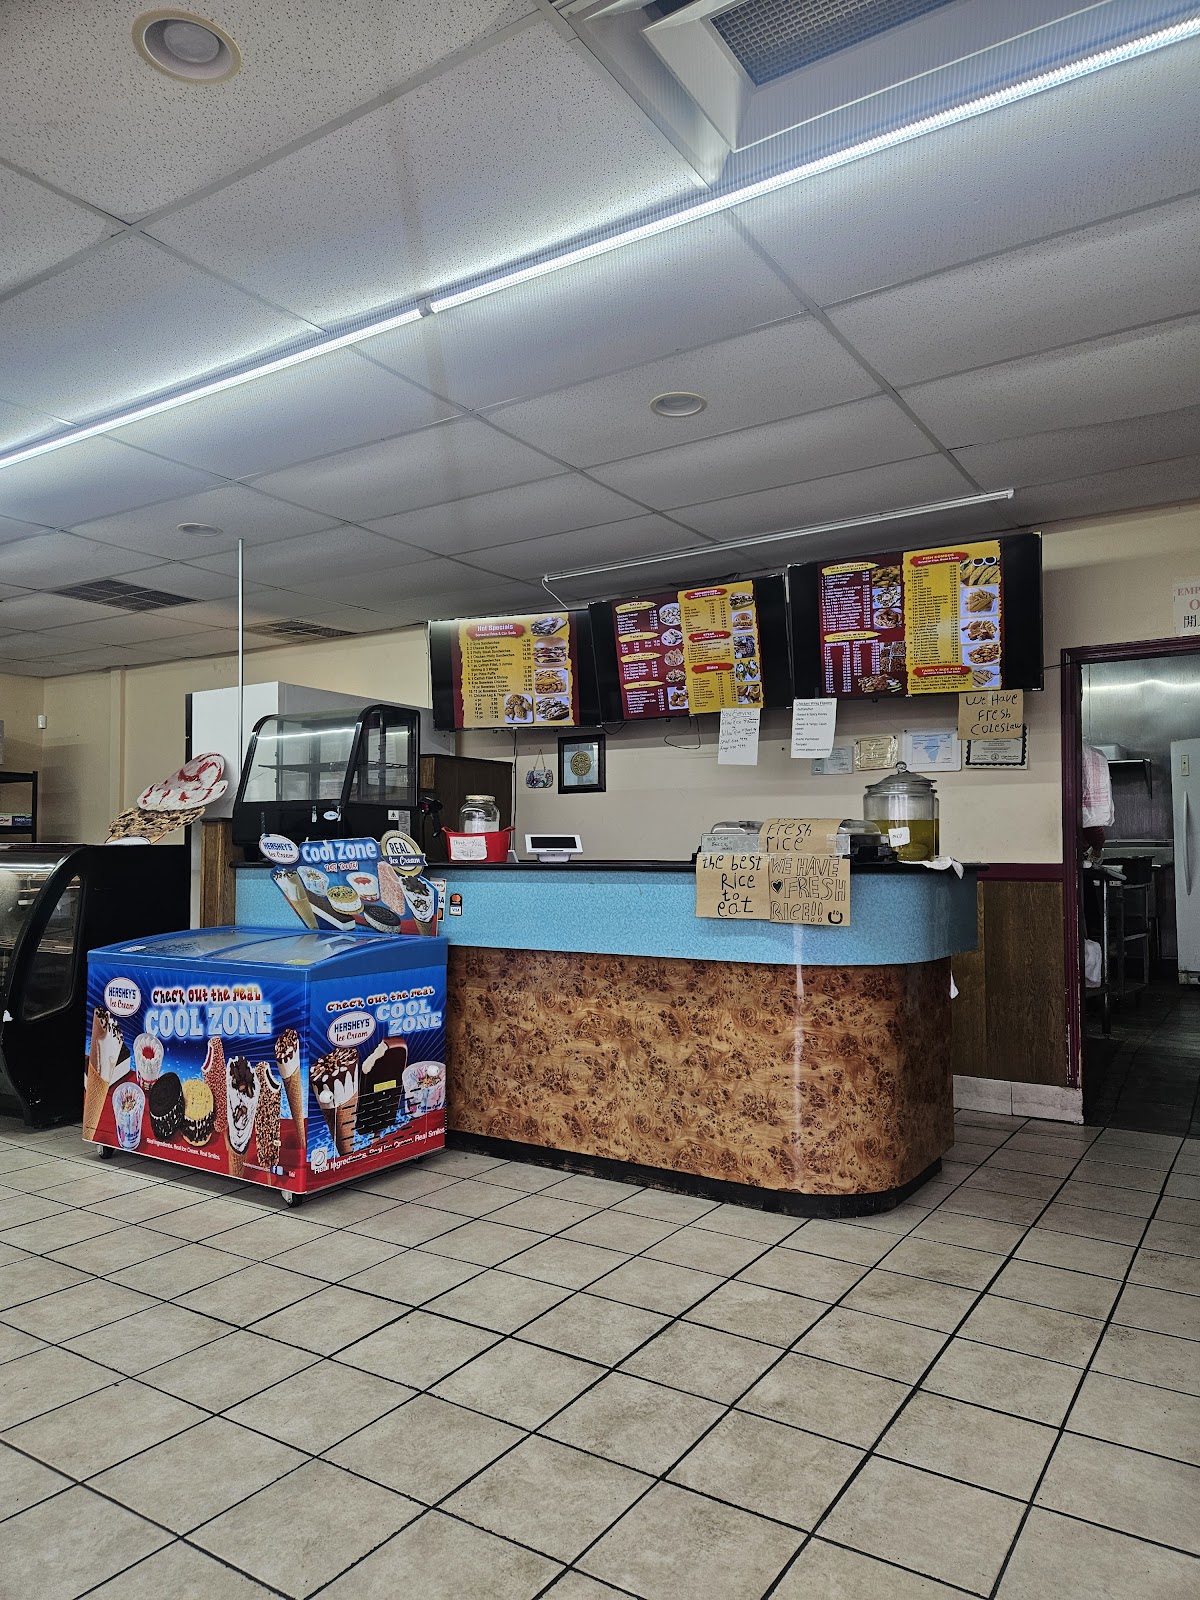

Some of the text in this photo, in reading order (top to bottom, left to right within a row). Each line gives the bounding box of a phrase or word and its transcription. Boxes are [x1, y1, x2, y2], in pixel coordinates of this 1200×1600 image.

[488, 623, 514, 631] Specials
[966, 694, 1018, 706] We Have
[978, 708, 1011, 721] Fresh
[262, 842, 293, 850] HERSHEY'S
[388, 842, 410, 854] REAL
[766, 836, 804, 852] rice
[302, 842, 377, 862] Cool Zone
[388, 856, 420, 866] Ice Cream
[702, 855, 764, 870] the best
[770, 856, 840, 878] WE HAVE
[722, 873, 756, 890] Rice
[784, 876, 846, 901] FRESH
[722, 890, 740, 902] to
[717, 896, 754, 917] eat
[770, 900, 823, 922] RICE!!
[108, 986, 137, 1000] HERSHEY'S
[188, 988, 208, 1002] out
[210, 988, 230, 1002] the
[368, 996, 388, 1005] out
[390, 992, 408, 1000] the
[118, 1000, 135, 1010] Cream
[376, 999, 430, 1020] COOL
[146, 1004, 272, 1037] COOL ZONE
[334, 1018, 370, 1033] HERSHEY'S
[390, 1012, 442, 1036] ZONE
[336, 1032, 368, 1042] Ice Cream
[414, 1132, 428, 1142] Real
[154, 1139, 174, 1149] Ingredients.
[208, 1151, 220, 1160] Smiles.
